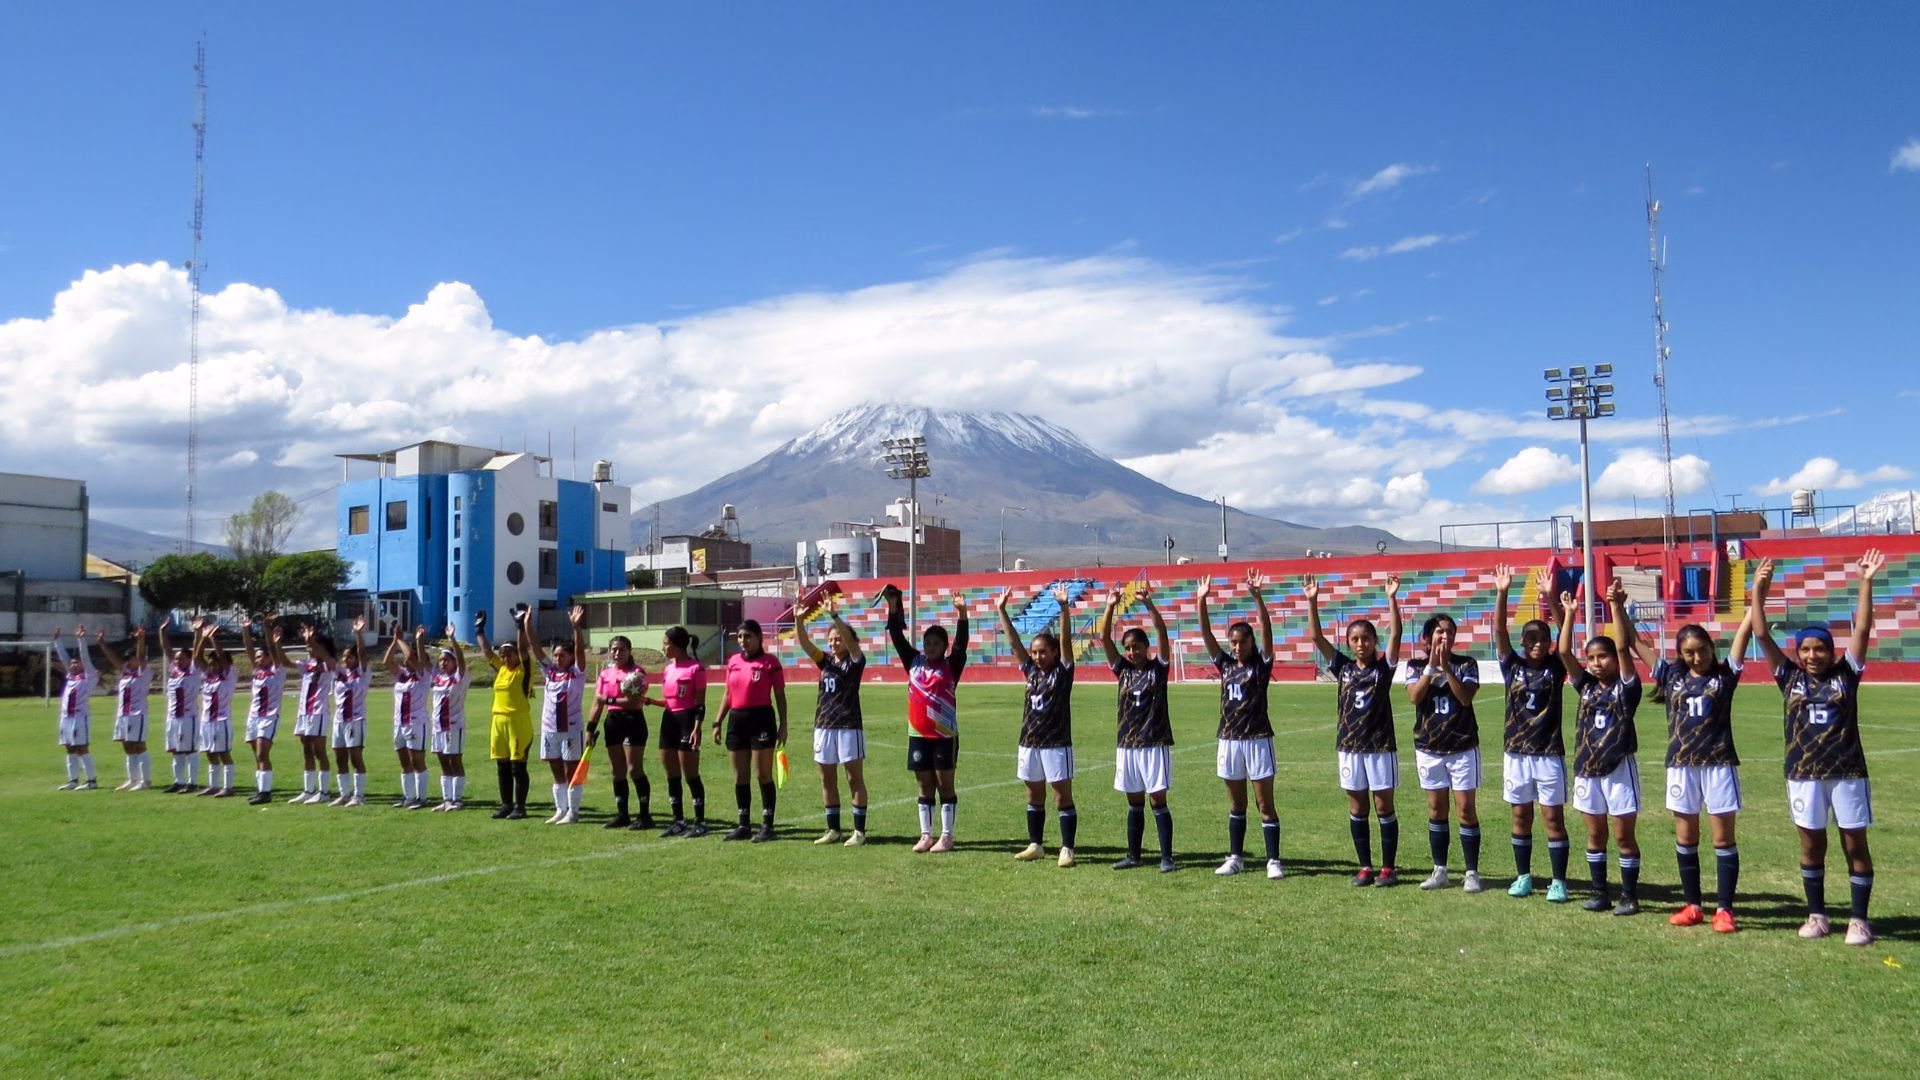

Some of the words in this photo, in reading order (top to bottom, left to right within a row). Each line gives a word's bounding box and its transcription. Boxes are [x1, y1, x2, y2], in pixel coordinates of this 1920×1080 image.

[824, 678, 836, 692] 19
[1227, 684, 1243, 701] 14
[1031, 695, 1043, 710] 10
[1355, 691, 1365, 709] 3
[1526, 692, 1536, 710] 2
[1686, 697, 1703, 717] 11
[1595, 710, 1606, 729] 6
[1806, 703, 1828, 724] 15
